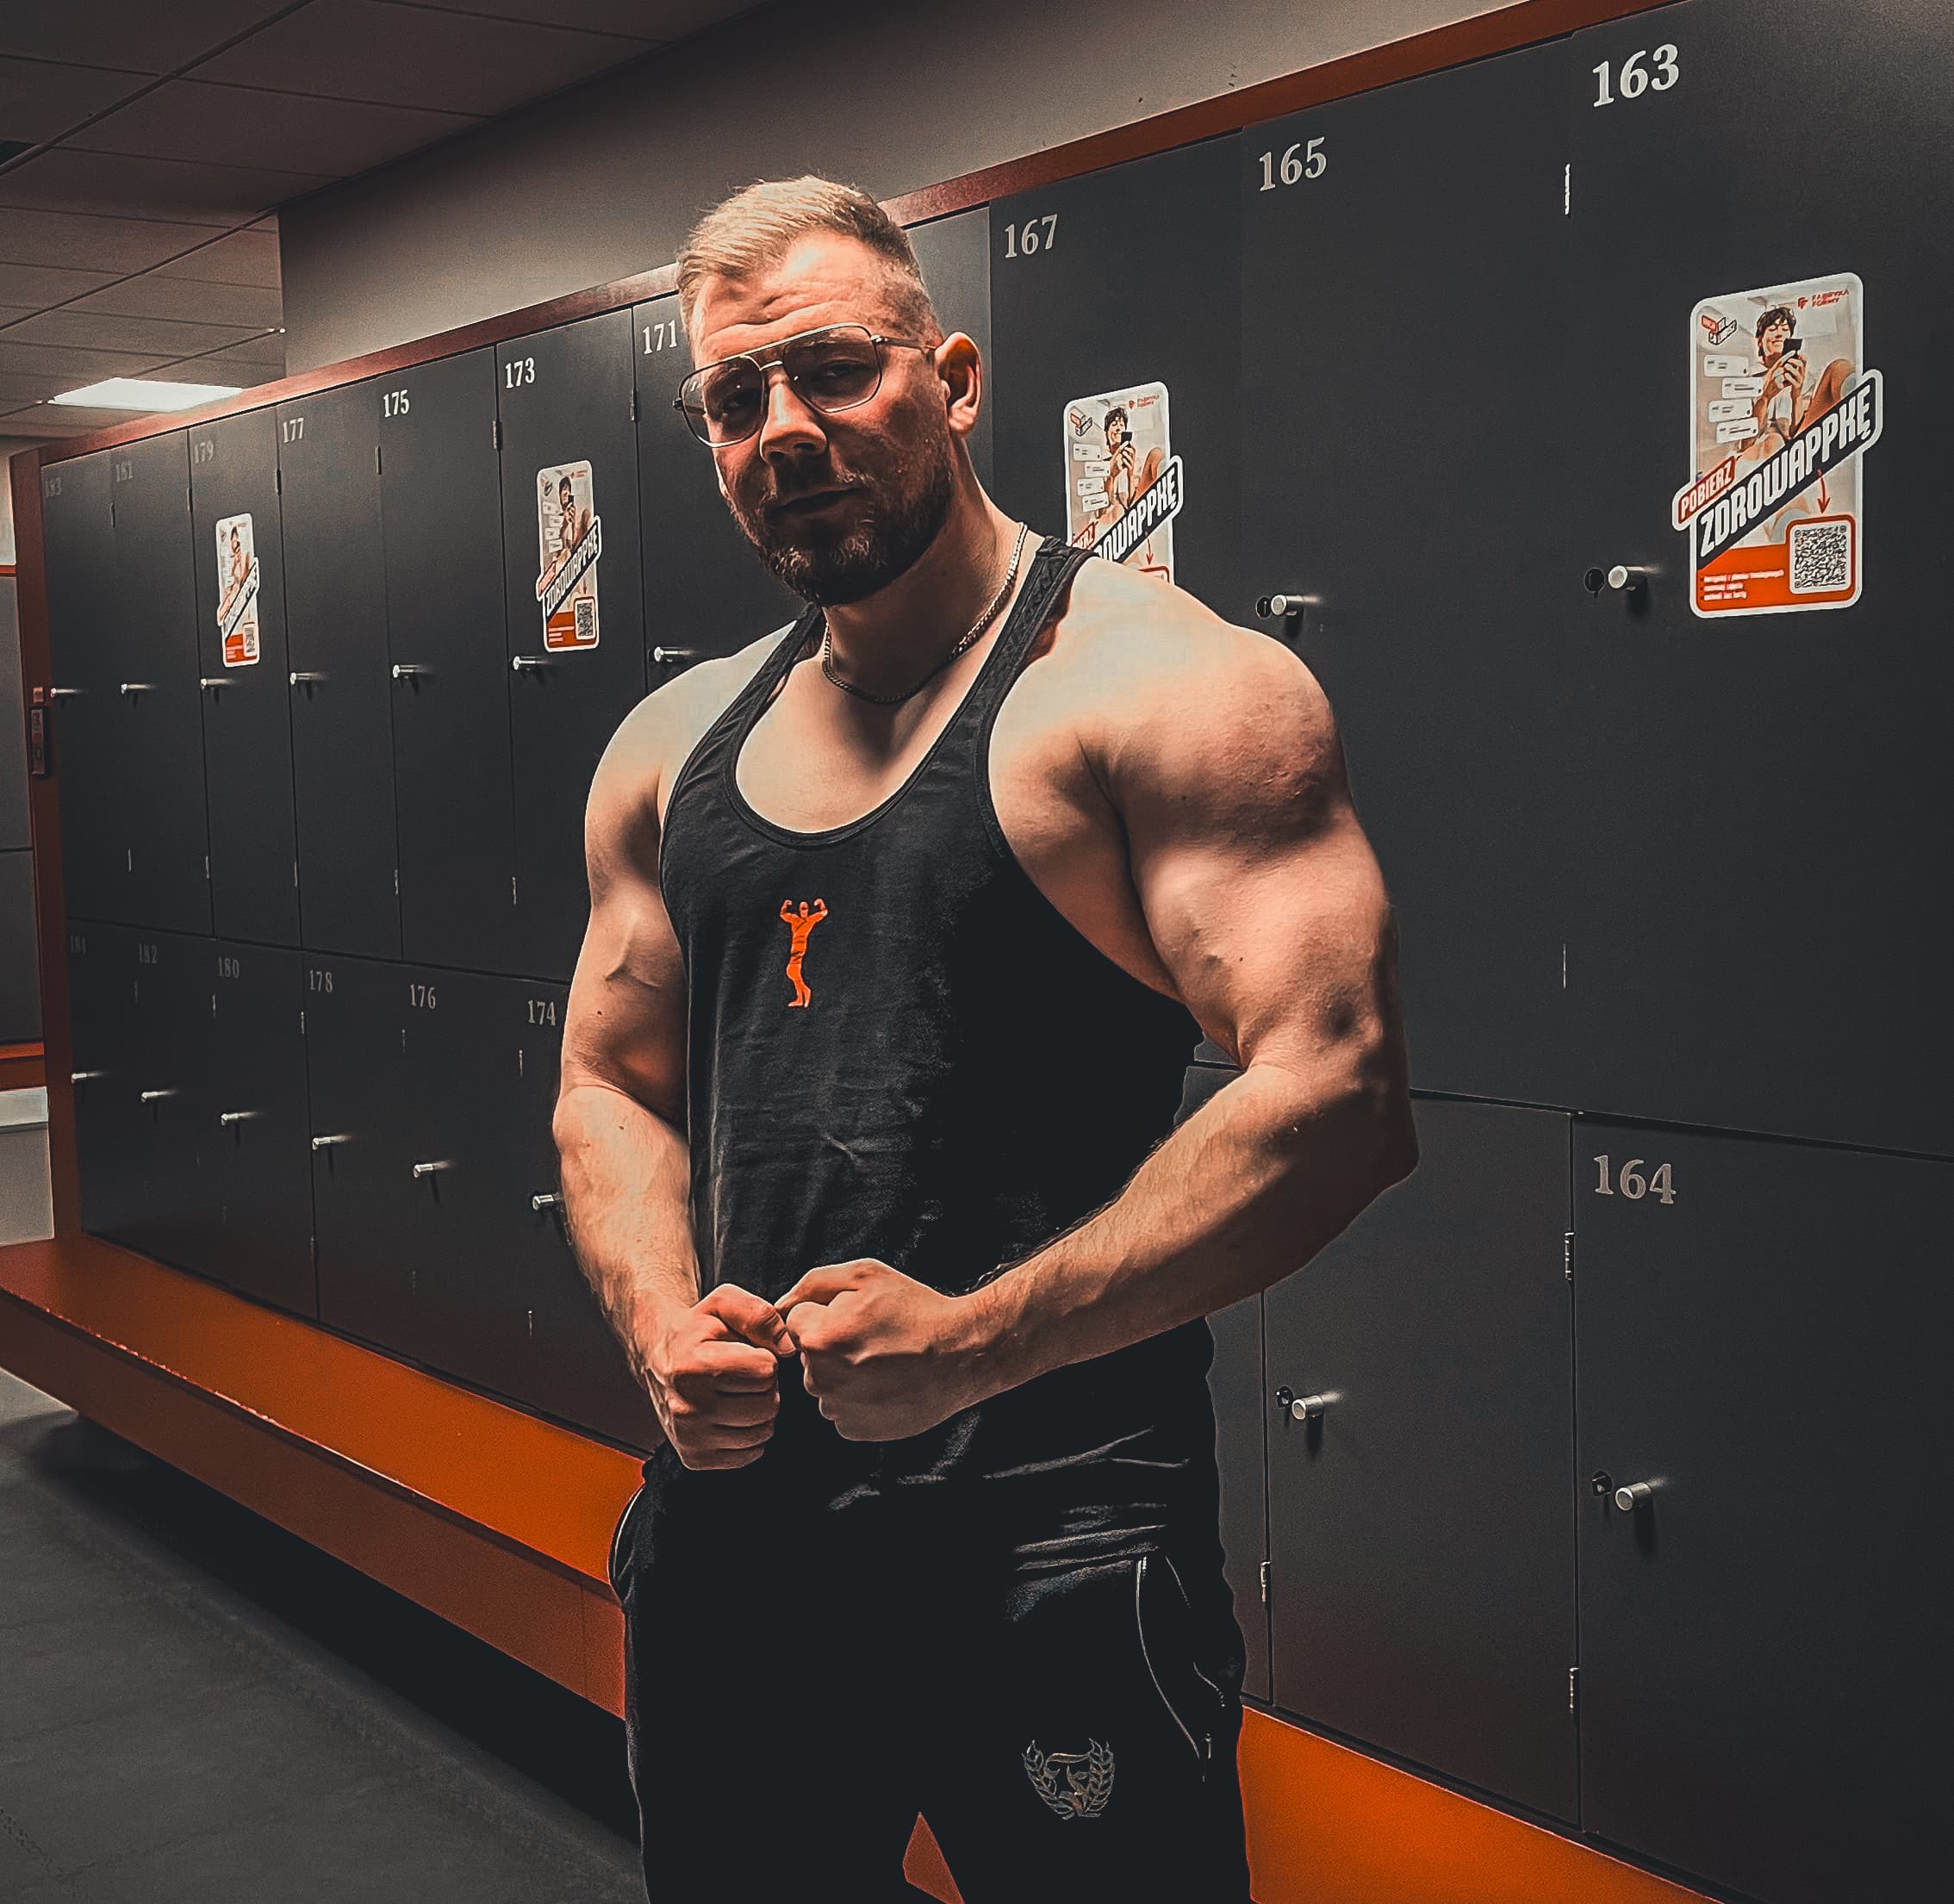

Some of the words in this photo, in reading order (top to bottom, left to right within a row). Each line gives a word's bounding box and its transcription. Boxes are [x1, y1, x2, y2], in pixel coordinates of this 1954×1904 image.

[1592, 43, 1679, 108] 163
[1259, 136, 1328, 192] 165
[1005, 214, 1059, 258] 167
[642, 320, 677, 354] 171
[505, 357, 535, 389] 173
[383, 389, 410, 418] 175
[283, 418, 304, 444] 177
[194, 440, 215, 464] 179
[1700, 384, 1871, 558] ZDROWAPPKĘ
[1681, 459, 1733, 520] POBIERZ
[1092, 466, 1177, 562] OWAPPKĘ
[139, 943, 159, 964] 182
[218, 957, 240, 979] 180
[309, 969, 333, 992] 178
[409, 984, 437, 1009] 176
[527, 999, 557, 1026] 174
[1593, 1154, 1677, 1204] 164
